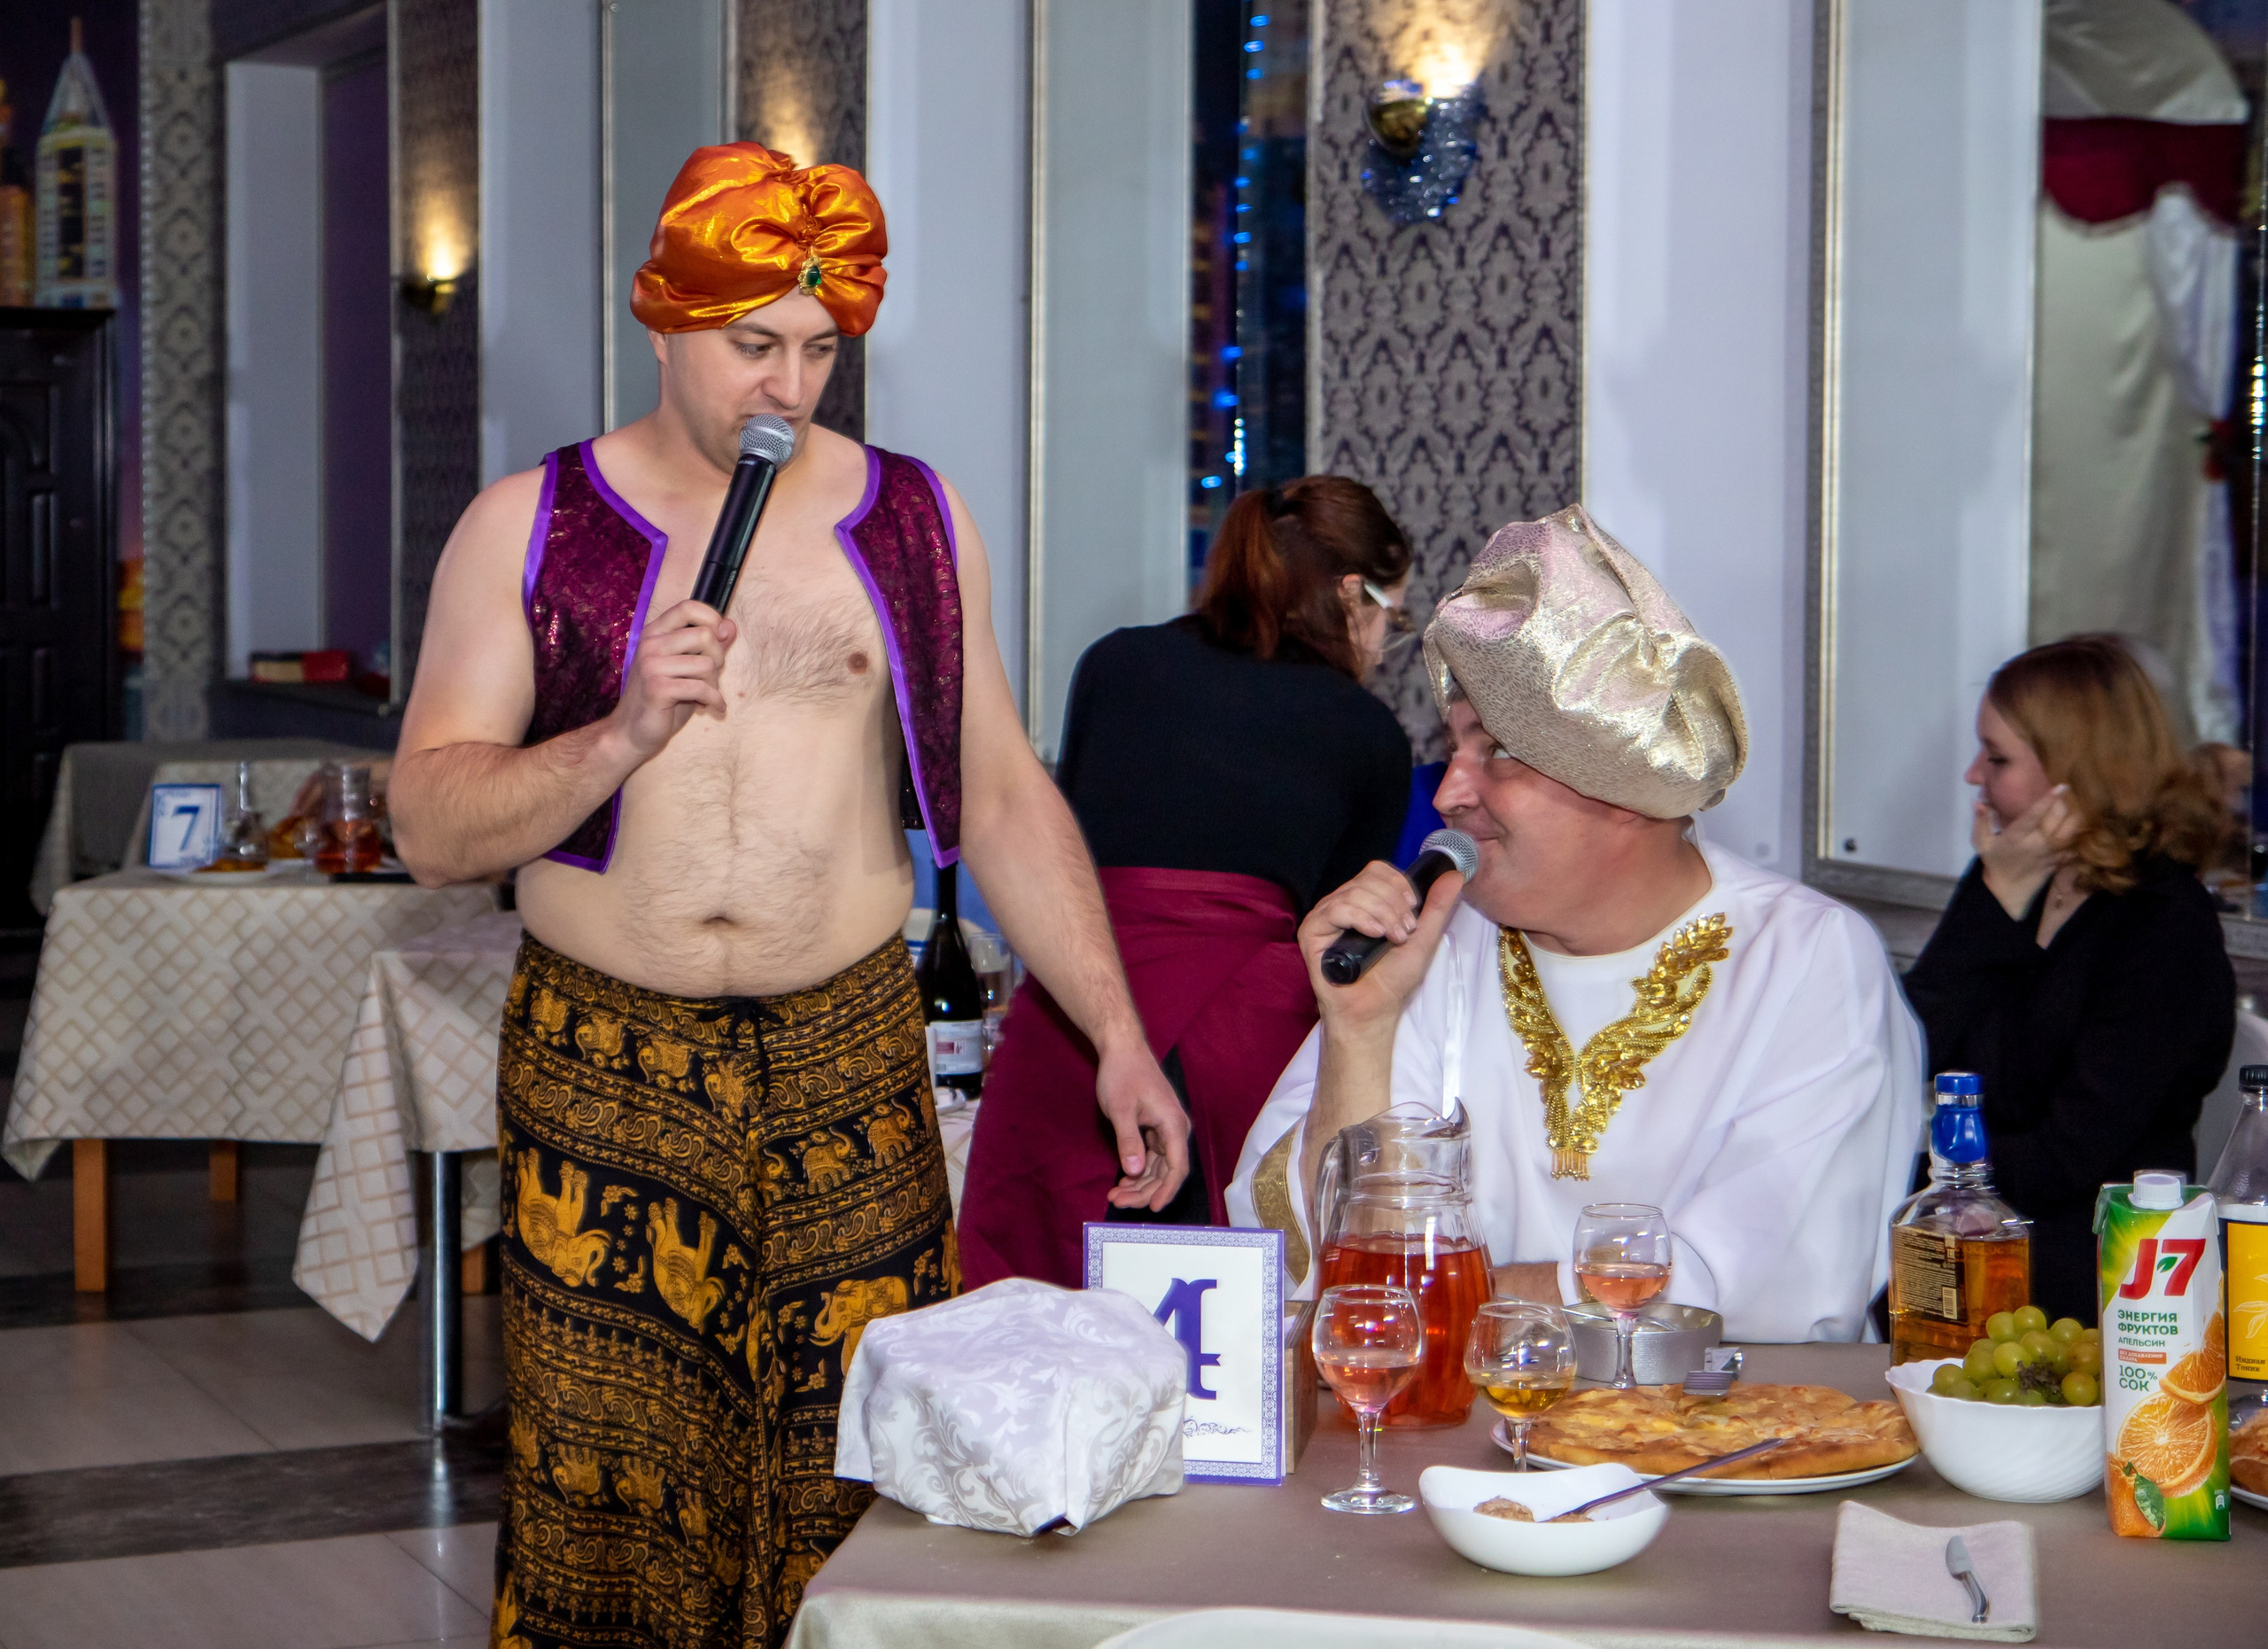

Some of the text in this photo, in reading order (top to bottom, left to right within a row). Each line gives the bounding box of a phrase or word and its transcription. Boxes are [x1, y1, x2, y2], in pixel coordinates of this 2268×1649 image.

[172, 805, 200, 852] 7
[2118, 1238, 2206, 1300] J7
[2117, 1309, 2179, 1323] ЭНЕРГИЯ
[2117, 1322, 2179, 1335] ФРУКТОВ
[1153, 1278, 1222, 1401] 4
[2117, 1336, 2166, 1347] АПЕЛЬСИН
[2235, 1363, 2261, 1373] Тоник
[2119, 1377, 2150, 1392] СОК
